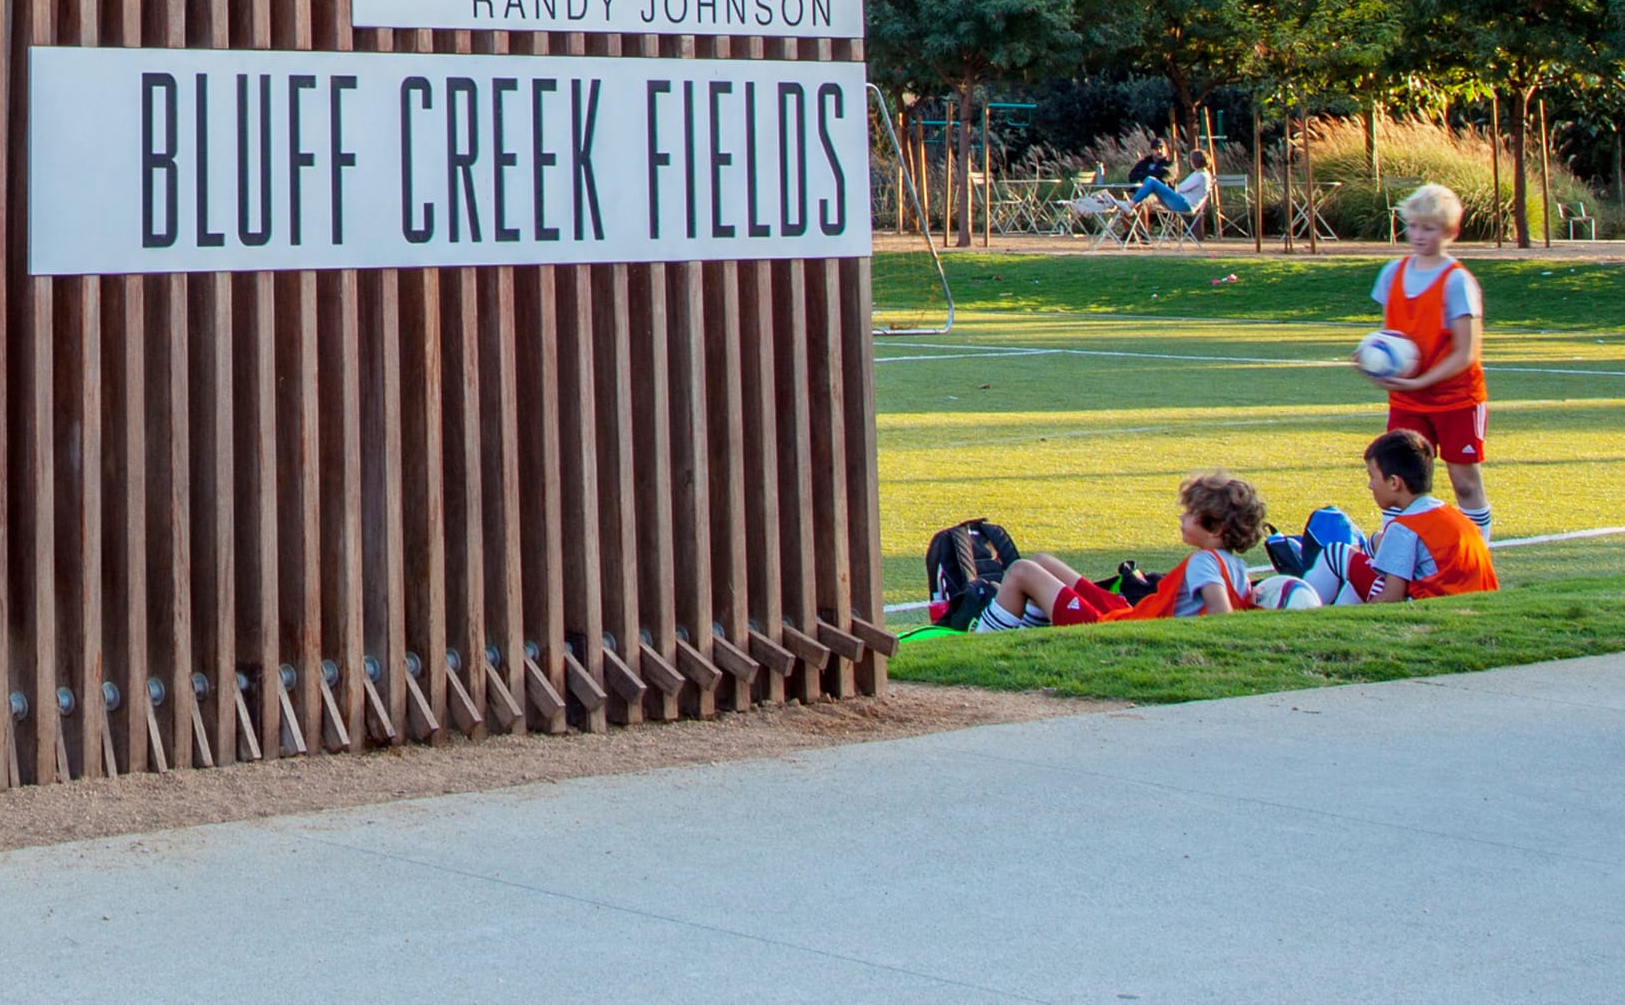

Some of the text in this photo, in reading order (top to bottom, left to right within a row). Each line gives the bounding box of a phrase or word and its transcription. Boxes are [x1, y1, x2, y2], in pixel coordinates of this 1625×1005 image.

[141, 72, 847, 249] BLUFF CREEK FIELDS
